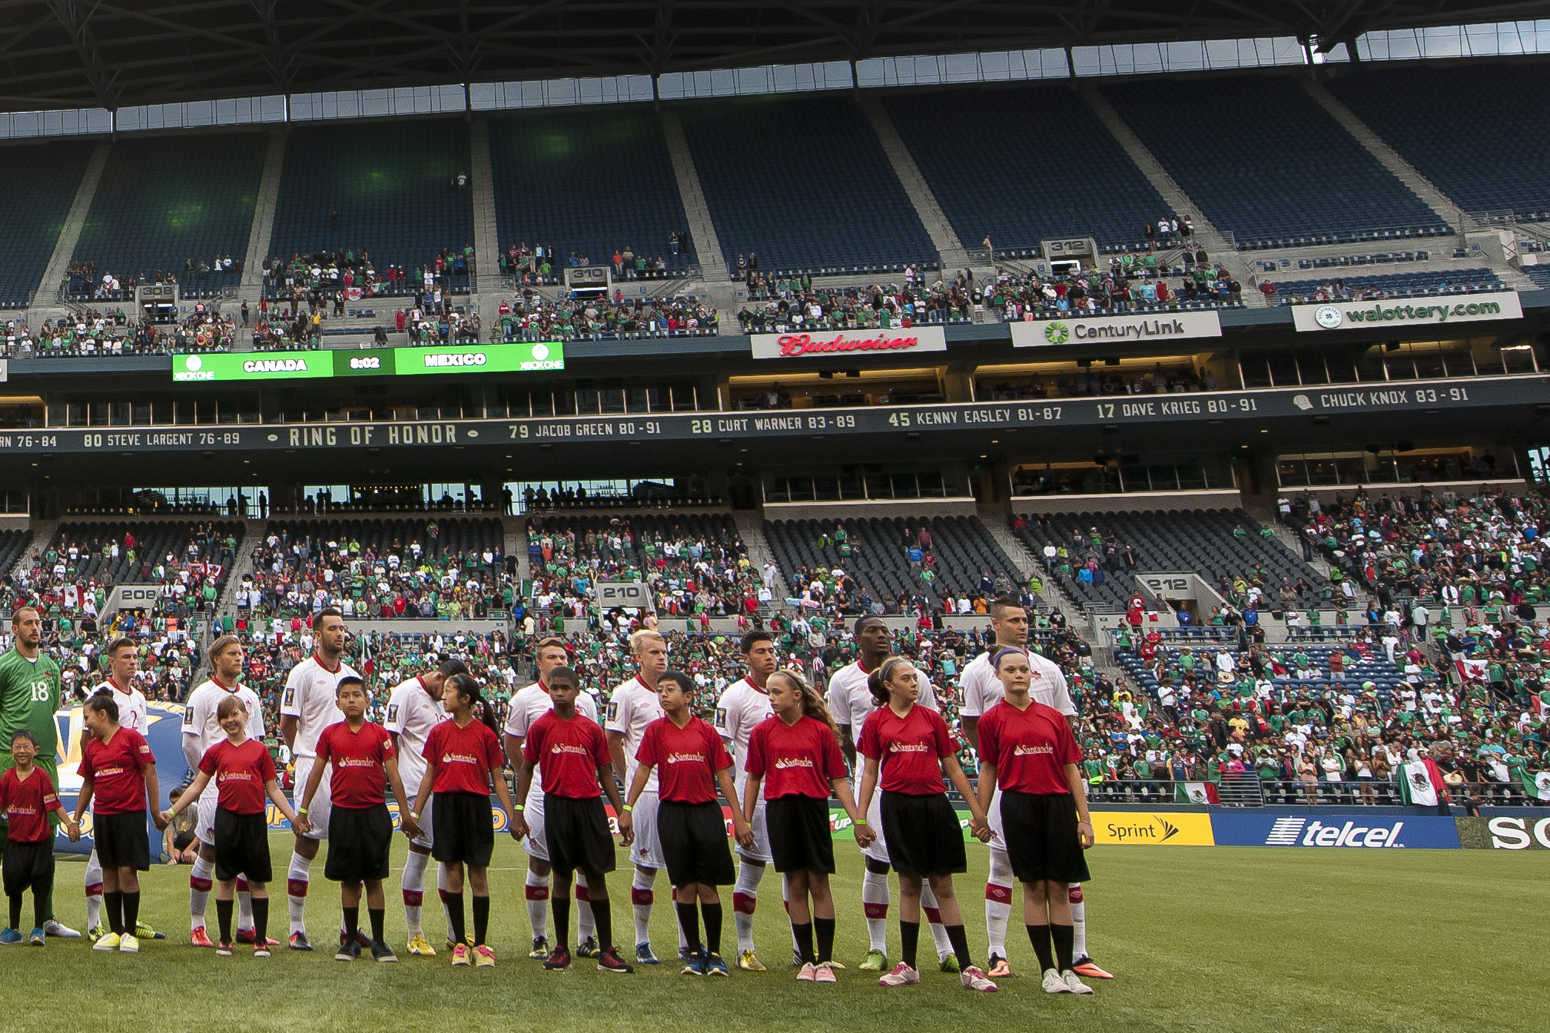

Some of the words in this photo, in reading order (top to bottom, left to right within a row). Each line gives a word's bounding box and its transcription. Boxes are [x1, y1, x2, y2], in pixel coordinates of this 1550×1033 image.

[1050, 241, 1086, 252] 312
[572, 269, 604, 280] 310
[1346, 300, 1500, 321] walottery.com
[1074, 319, 1185, 339] CenturyLink
[778, 333, 918, 357] Budweiser
[243, 358, 308, 372] CANADA
[349, 356, 381, 369] 8:02
[423, 353, 487, 367] MEXICO
[1320, 393, 1367, 408] CHUCK
[1369, 390, 1408, 405] KNOX
[1096, 404, 1115, 419] 17
[1122, 403, 1154, 417] DAVE
[1161, 401, 1201, 415] KRIEG
[888, 412, 910, 427] 45
[916, 410, 958, 425] KENNY
[964, 409, 1011, 423] EASLEY
[508, 425, 529, 439] 79
[535, 424, 571, 437] JACOB
[575, 423, 613, 436] GREEN
[691, 420, 712, 434] 28
[718, 419, 748, 432] CURT
[755, 417, 802, 431] WARNER
[84, 434, 102, 447] 80
[107, 433, 141, 446] STEVE
[146, 433, 193, 446] LARGENT
[289, 428, 337, 446] RING
[350, 426, 375, 445] OF
[388, 424, 457, 445] HONOR
[1147, 577, 1188, 590] 212
[121, 588, 157, 600] 208
[603, 586, 640, 599] 210
[30, 681, 50, 702] 18
[130, 709, 139, 729] 2
[897, 740, 929, 753] Santander
[344, 756, 375, 767] Santander
[450, 752, 478, 764] Santander
[675, 750, 705, 763] Santander
[783, 756, 814, 768] Santander
[223, 770, 252, 781] Santander
[10, 804, 37, 815] Santander
[1107, 822, 1156, 841] Sprint
[1302, 820, 1404, 848] telcel
